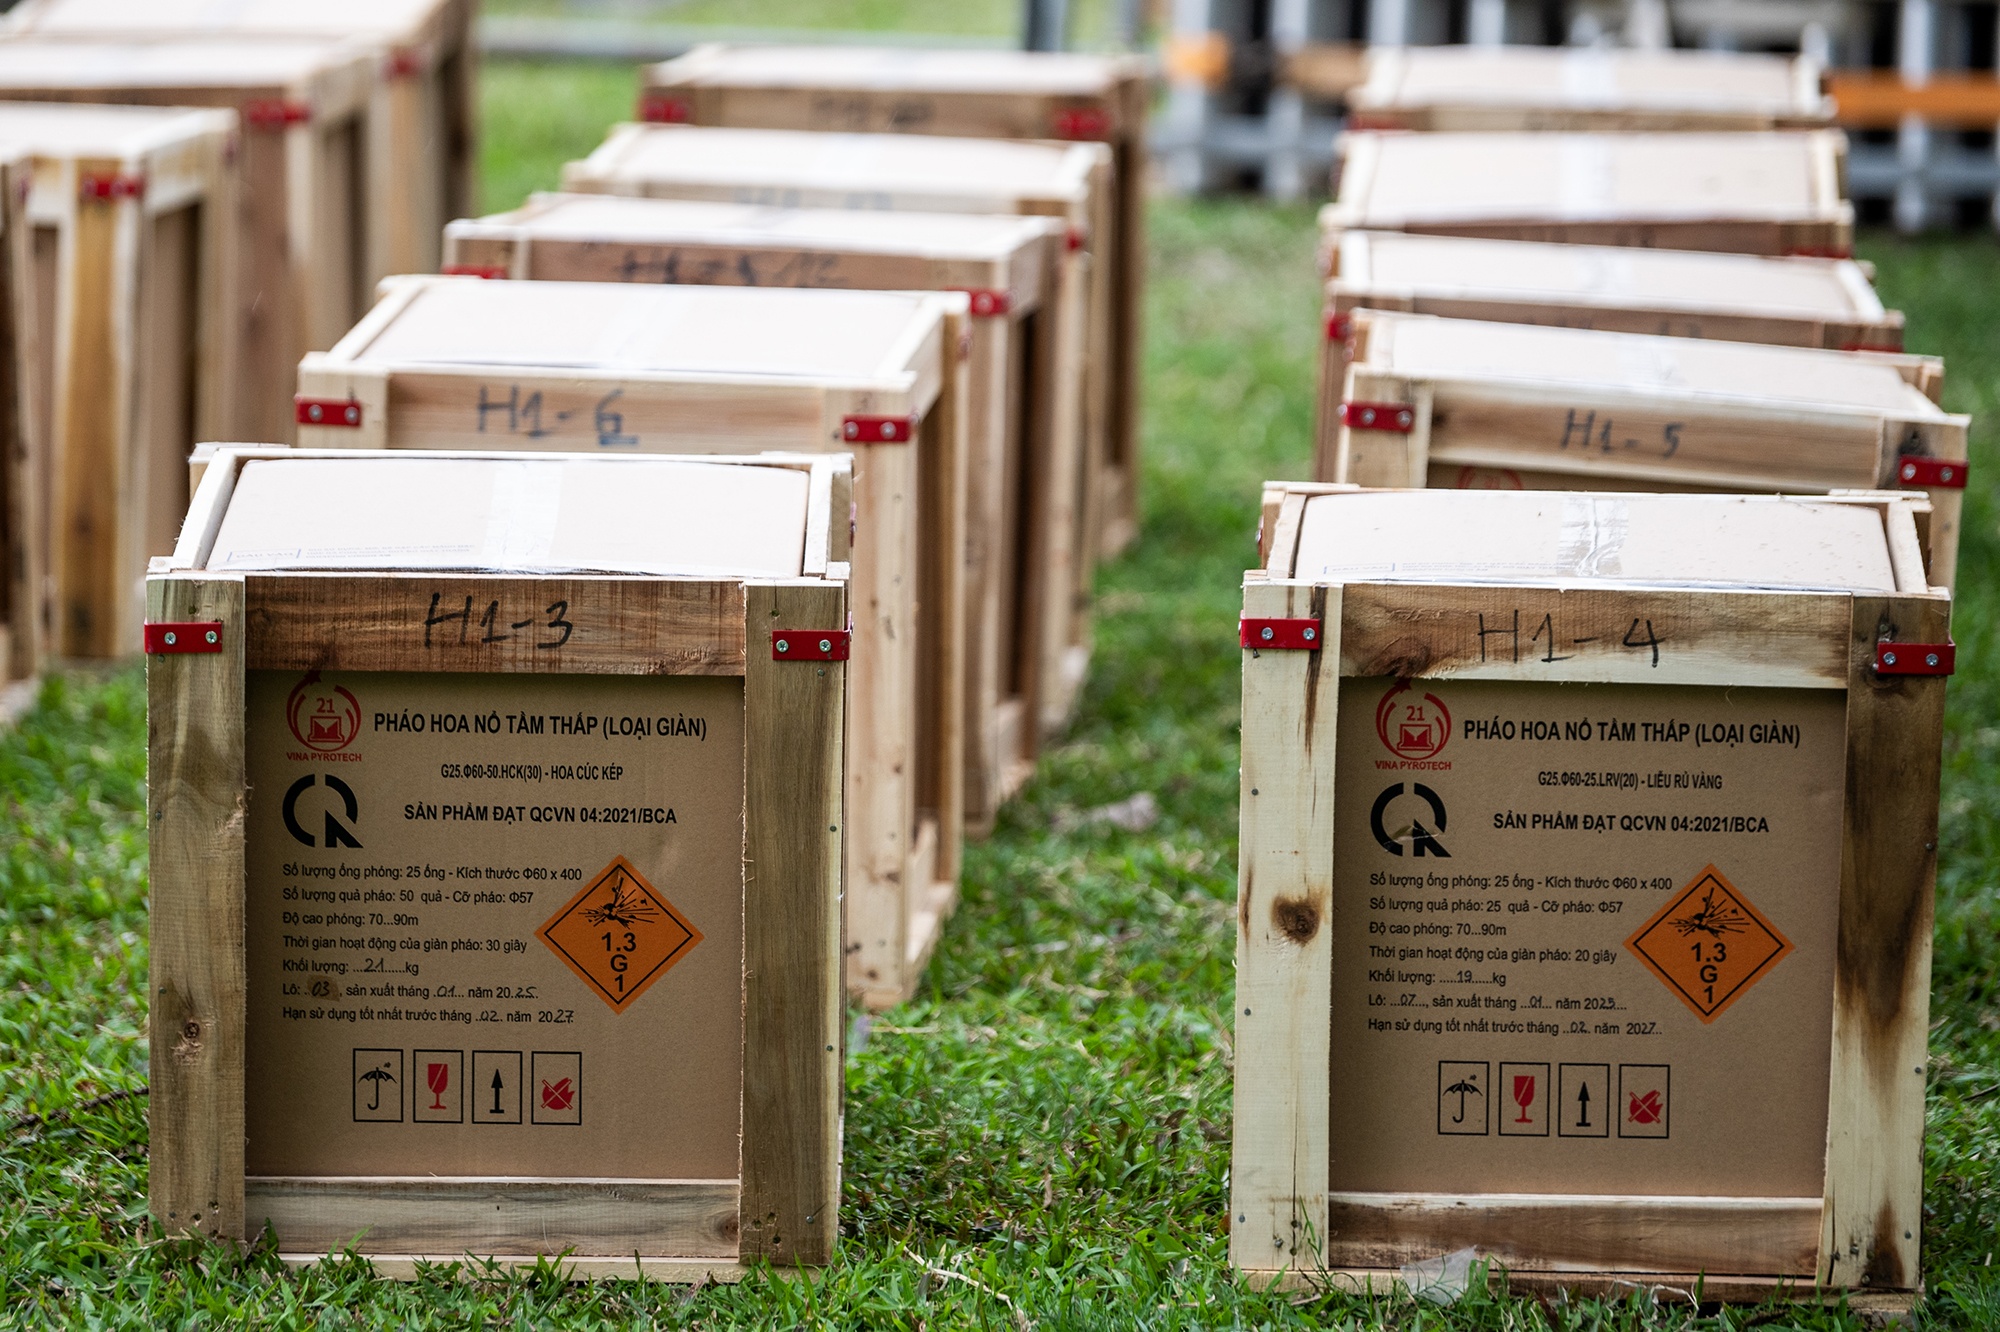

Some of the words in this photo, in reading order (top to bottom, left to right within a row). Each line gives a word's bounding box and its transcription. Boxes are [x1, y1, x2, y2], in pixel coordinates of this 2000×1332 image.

[316, 697, 335, 714] 21
[1406, 705, 1425, 721] 21
[374, 708, 425, 733] PHÁO
[430, 714, 470, 733] HOA
[474, 710, 501, 734] NỔ
[506, 711, 544, 735] TẦM
[549, 712, 598, 735] THẤP
[603, 716, 651, 741] (LOẠI
[656, 713, 707, 742] GIÀN)
[1464, 715, 1516, 740] PHÁO
[1521, 720, 1561, 741] HOA
[1565, 717, 1592, 741] NỔ
[1597, 717, 1636, 742] TẦM
[1641, 719, 1690, 742] THẤP
[1695, 723, 1744, 748] (LOẠI
[1749, 719, 1800, 749] GIÀN)
[286, 751, 309, 762] VINA
[311, 752, 362, 763] PYROTECH
[1375, 760, 1398, 770] VINA
[1400, 761, 1452, 771] PYROTECH
[551, 765, 574, 780] HOA
[576, 762, 599, 780] CÚC
[602, 762, 623, 781] KÉP
[1647, 770, 1671, 788] LIỄU
[1674, 770, 1689, 789] RỦ
[1692, 771, 1723, 789] VÀNG
[404, 801, 437, 820] SẢN
[442, 802, 488, 821] PHẨM
[492, 806, 526, 825] ĐẠT
[529, 806, 575, 822] QCVN
[580, 807, 677, 824] 04:2021/BCA
[1493, 810, 1527, 829] SẢN
[1532, 810, 1578, 830] PHẨM
[1582, 815, 1616, 834] ĐẠT
[1620, 815, 1666, 831] QCVN
[1671, 816, 1770, 833] 04:2021/BCA
[282, 862, 299, 876] Số
[301, 864, 336, 880] lượng
[338, 863, 360, 880] ống
[363, 866, 403, 881] phóng:
[406, 866, 421, 878] 25
[423, 864, 446, 881] ống
[456, 866, 482, 879] Kích
[485, 867, 520, 880] thước
[550, 871, 558, 880] x
[560, 868, 582, 881] 400
[1370, 871, 1386, 886] Số
[1389, 873, 1423, 889] lượng
[1426, 872, 1449, 889] ống
[1452, 875, 1491, 890] phóng:
[1494, 875, 1509, 888] 25
[1512, 873, 1534, 890] ống
[1545, 876, 1571, 889] Kích
[1574, 877, 1610, 890] thước
[1640, 880, 1648, 890] x
[1650, 878, 1673, 890] 400
[282, 886, 299, 900] Số
[301, 889, 336, 904] lượng
[338, 889, 361, 904] quả
[363, 889, 396, 904] pháo:
[399, 890, 414, 901] 50
[420, 890, 442, 904] quả
[452, 891, 471, 903] Cỡ
[474, 890, 506, 905] pháo:
[1370, 896, 1386, 910] Số
[1389, 898, 1423, 913] lượng
[1426, 898, 1449, 913] quả
[1452, 899, 1484, 913] pháo:
[1486, 900, 1501, 913] 25
[1507, 900, 1530, 915] quả
[1541, 900, 1560, 913] Cỡ
[1562, 900, 1595, 915] pháo:
[282, 911, 300, 926] Độ
[302, 914, 323, 925] cao
[326, 913, 365, 928] phóng:
[1369, 922, 1387, 936] Độ
[1389, 925, 1410, 935] cao
[1413, 923, 1453, 938] phóng:
[282, 935, 309, 948] Thời
[312, 938, 337, 951] gian
[340, 938, 365, 951] hoạt
[367, 938, 396, 951] động
[399, 937, 420, 949] của
[423, 938, 448, 952] giàn
[451, 939, 483, 953] pháo:
[486, 939, 500, 952] 30
[503, 939, 527, 954] giây
[601, 932, 637, 952] 1.3
[1369, 945, 1395, 958] Thời
[1398, 947, 1423, 961] gian
[1426, 947, 1452, 961] hoạt
[1455, 947, 1484, 962] động
[1487, 947, 1508, 960] của
[1511, 948, 1536, 963] giàn
[1539, 949, 1571, 963] pháo:
[1575, 949, 1590, 962] 20
[1593, 950, 1617, 965] giây
[1691, 942, 1727, 962] 1.3
[282, 957, 309, 972] Khối
[311, 960, 349, 975] lượng:
[610, 954, 628, 972] G
[614, 974, 624, 992] 1
[1369, 968, 1395, 982] Khối
[1398, 970, 1436, 985] lượng:
[1700, 965, 1718, 983] G
[282, 983, 301, 996] Lô:
[346, 984, 367, 997] sản
[370, 983, 394, 997] xuất
[397, 984, 430, 1000] tháng
[468, 986, 493, 999] năm
[1703, 985, 1713, 1004] 1
[1369, 994, 1386, 1006] Lô:
[1432, 994, 1454, 1008] sản
[1456, 993, 1481, 1008] xuất
[1484, 996, 1517, 1011] tháng
[1555, 997, 1581, 1010] năm
[282, 1007, 306, 1021] Hạn
[309, 1007, 325, 1019] sử
[328, 1008, 356, 1023] dụng
[360, 1006, 375, 1020] tốt
[377, 1006, 403, 1021] nhất
[405, 1009, 437, 1021] trước
[440, 1010, 472, 1024] tháng
[506, 1010, 532, 1023] năm
[1368, 1018, 1392, 1032] Hạn
[1395, 1018, 1411, 1030] sử
[1413, 1019, 1442, 1034] dụng
[1445, 1017, 1461, 1032] tốt
[1463, 1018, 1489, 1032] nhất
[1492, 1020, 1524, 1033] trước
[1526, 1021, 1559, 1036] tháng
[1594, 1022, 1620, 1035] năm
